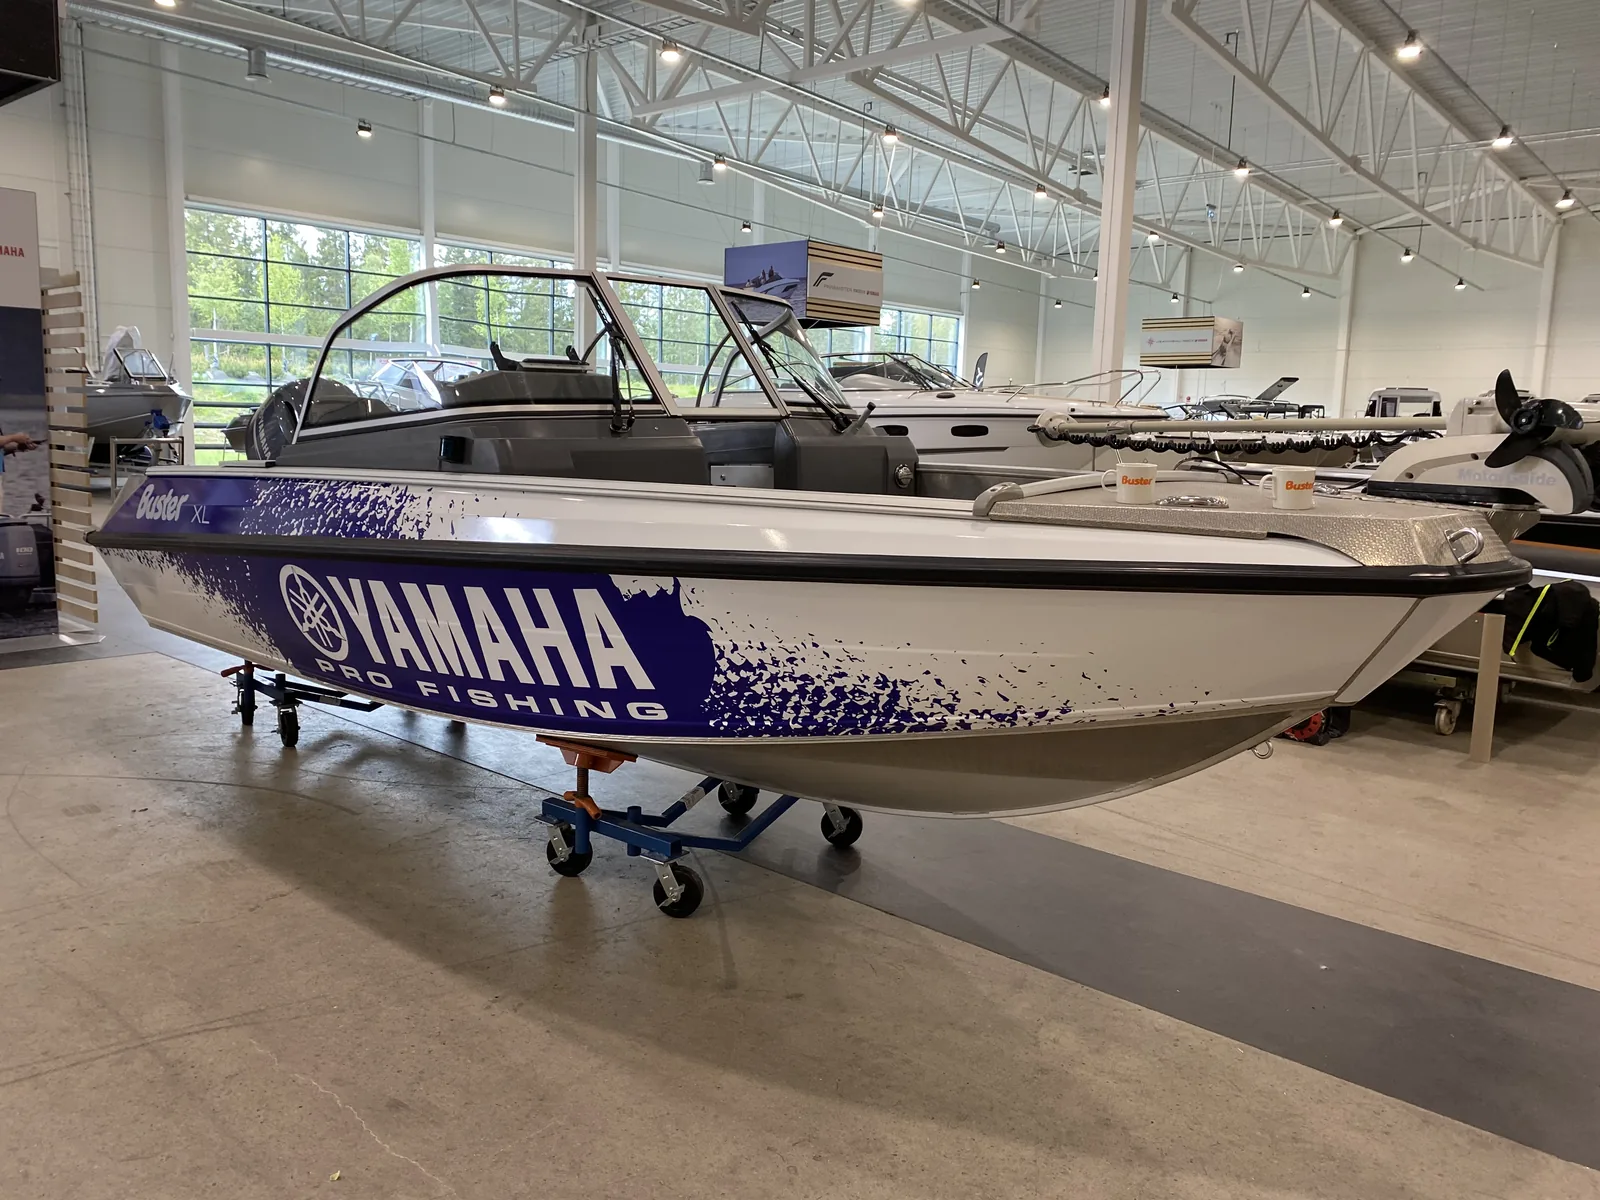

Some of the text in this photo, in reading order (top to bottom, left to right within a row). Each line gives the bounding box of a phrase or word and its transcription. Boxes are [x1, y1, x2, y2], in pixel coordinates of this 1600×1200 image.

[1121, 475, 1152, 485] Buster
[1457, 467, 1557, 486] MotorGuide
[136, 483, 210, 524] Buster XL
[326, 575, 656, 690] YAMAHA
[314, 657, 669, 721] PRO FISHING
